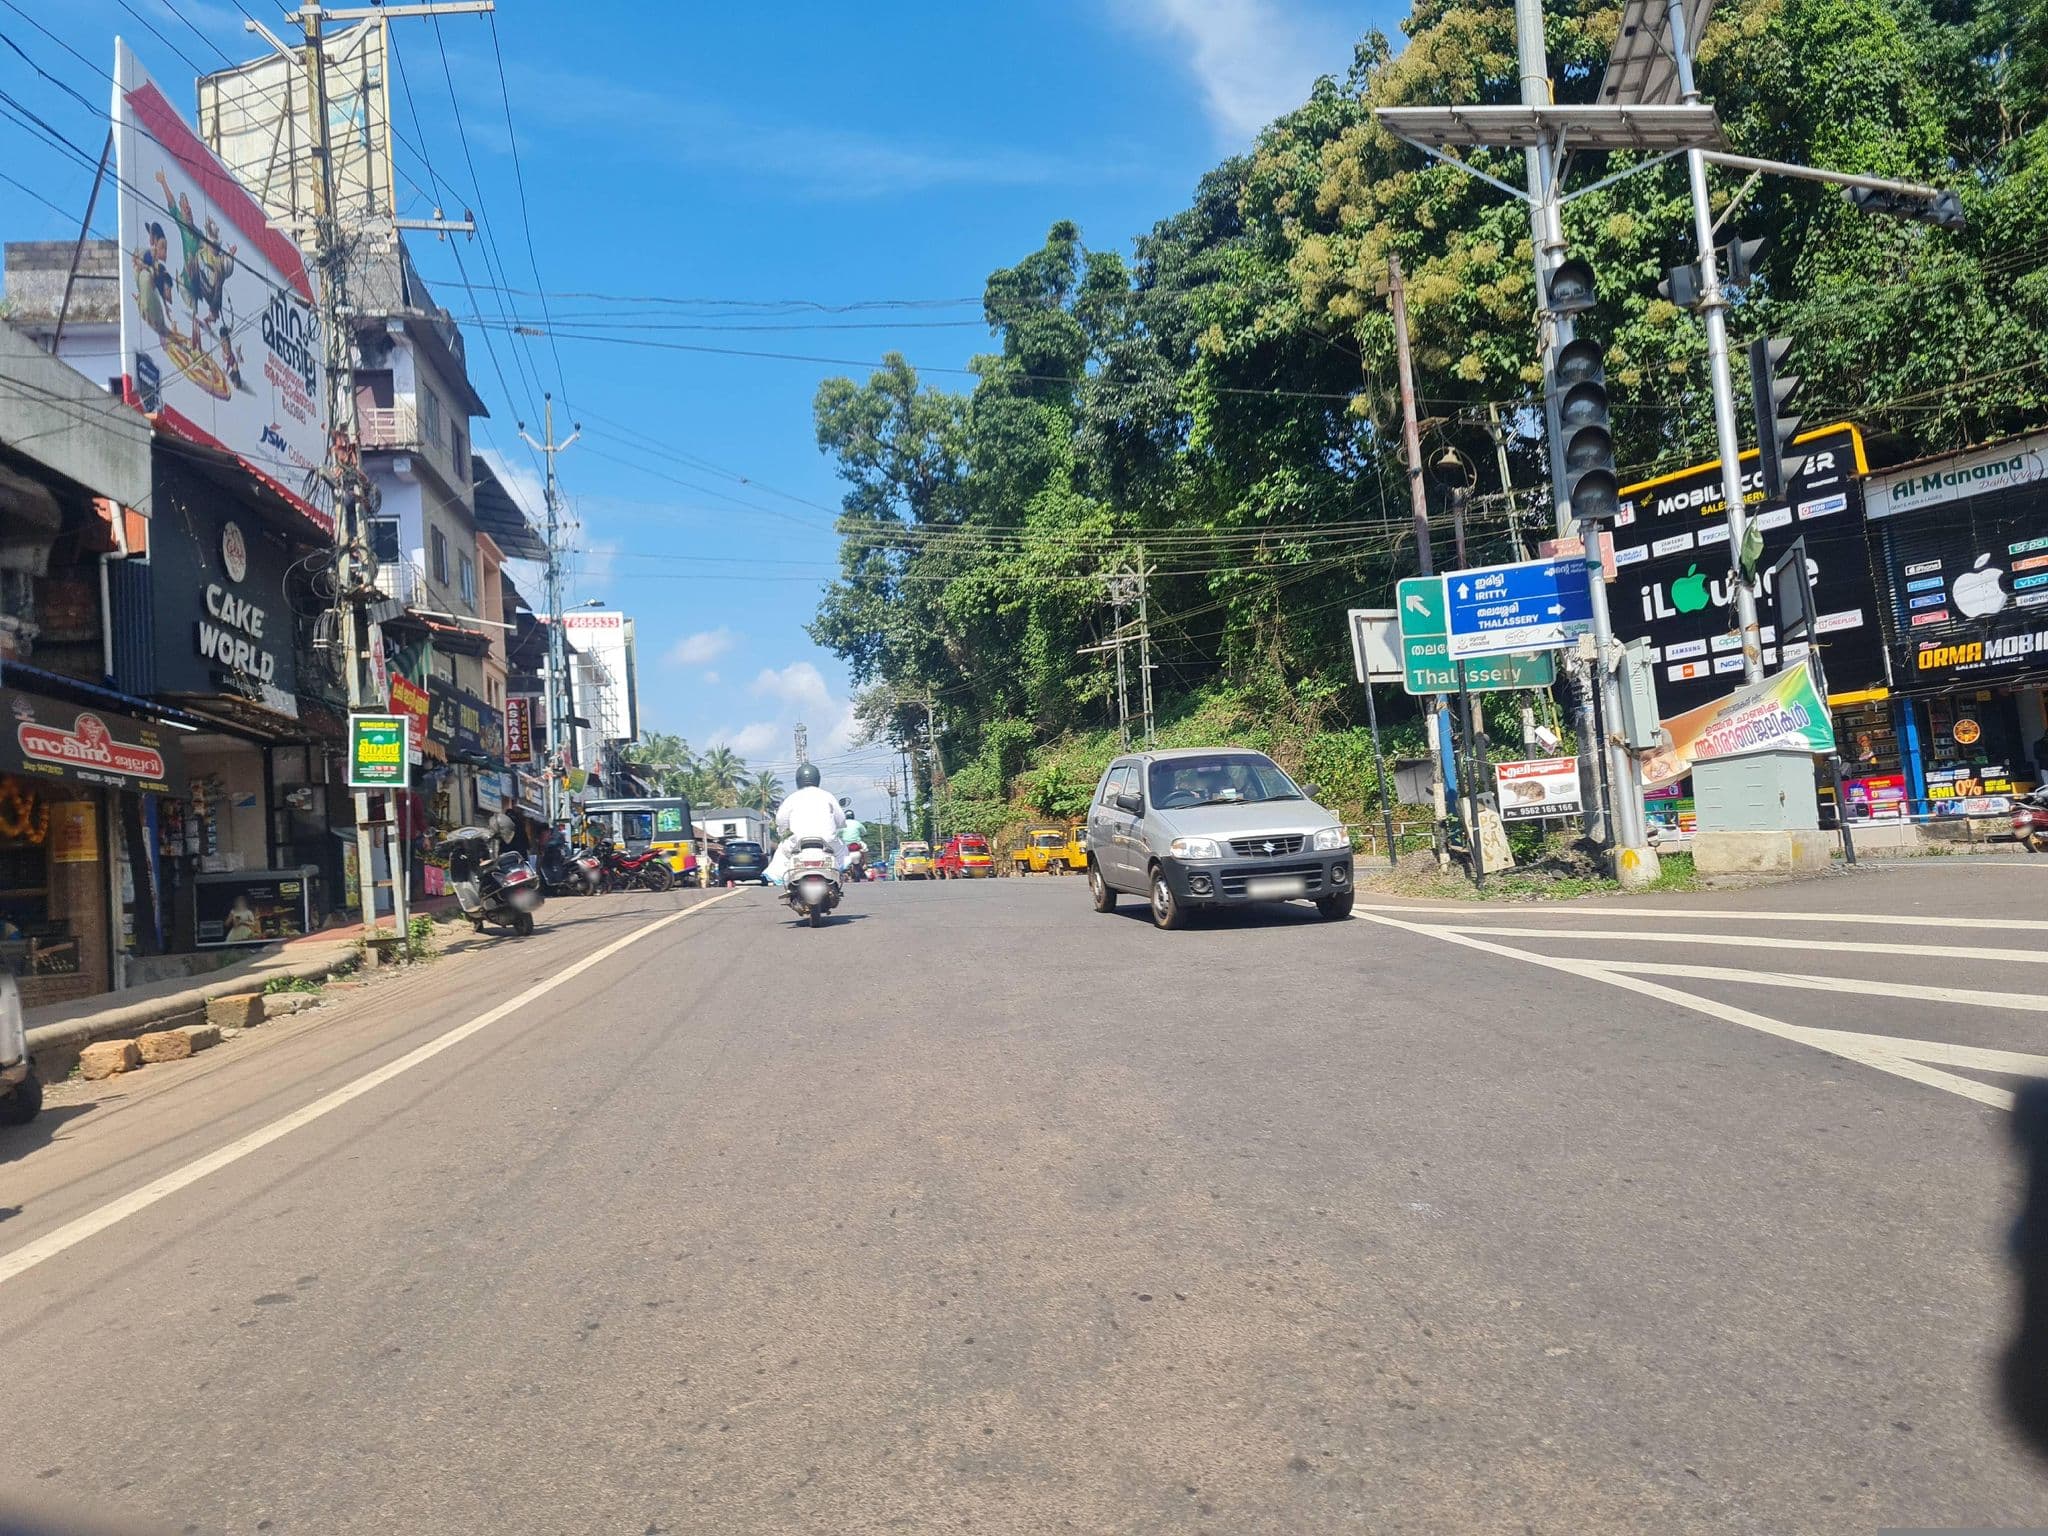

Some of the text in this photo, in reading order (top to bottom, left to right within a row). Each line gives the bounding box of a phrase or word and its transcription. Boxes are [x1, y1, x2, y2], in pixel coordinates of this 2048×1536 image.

[260, 425, 287, 452] JSW
[1892, 456, 2022, 501] Al-Manama
[1743, 490, 1766, 503] SERV
[1475, 573, 1504, 590] ഇരിട്ടി
[2019, 576, 2047, 586] vivo
[1475, 588, 1508, 601] IRITTY
[206, 584, 265, 638] CAKE
[1477, 602, 1519, 618] തലശ്ശേരി
[1478, 614, 1539, 629] THALASSERY
[1719, 636, 1743, 646] opp
[200, 621, 274, 681] WORLD
[1770, 648, 1801, 660] ralme
[1919, 642, 1982, 670] ORMA
[1720, 658, 1744, 668] NOK
[1992, 656, 2024, 665] SERVICE
[1413, 667, 1521, 684] Thalssery
[508, 701, 521, 752] ASRAYA
[1928, 786, 1955, 800] EMI
[1955, 777, 1983, 797] 0%
[1520, 806, 1540, 816] 9562
